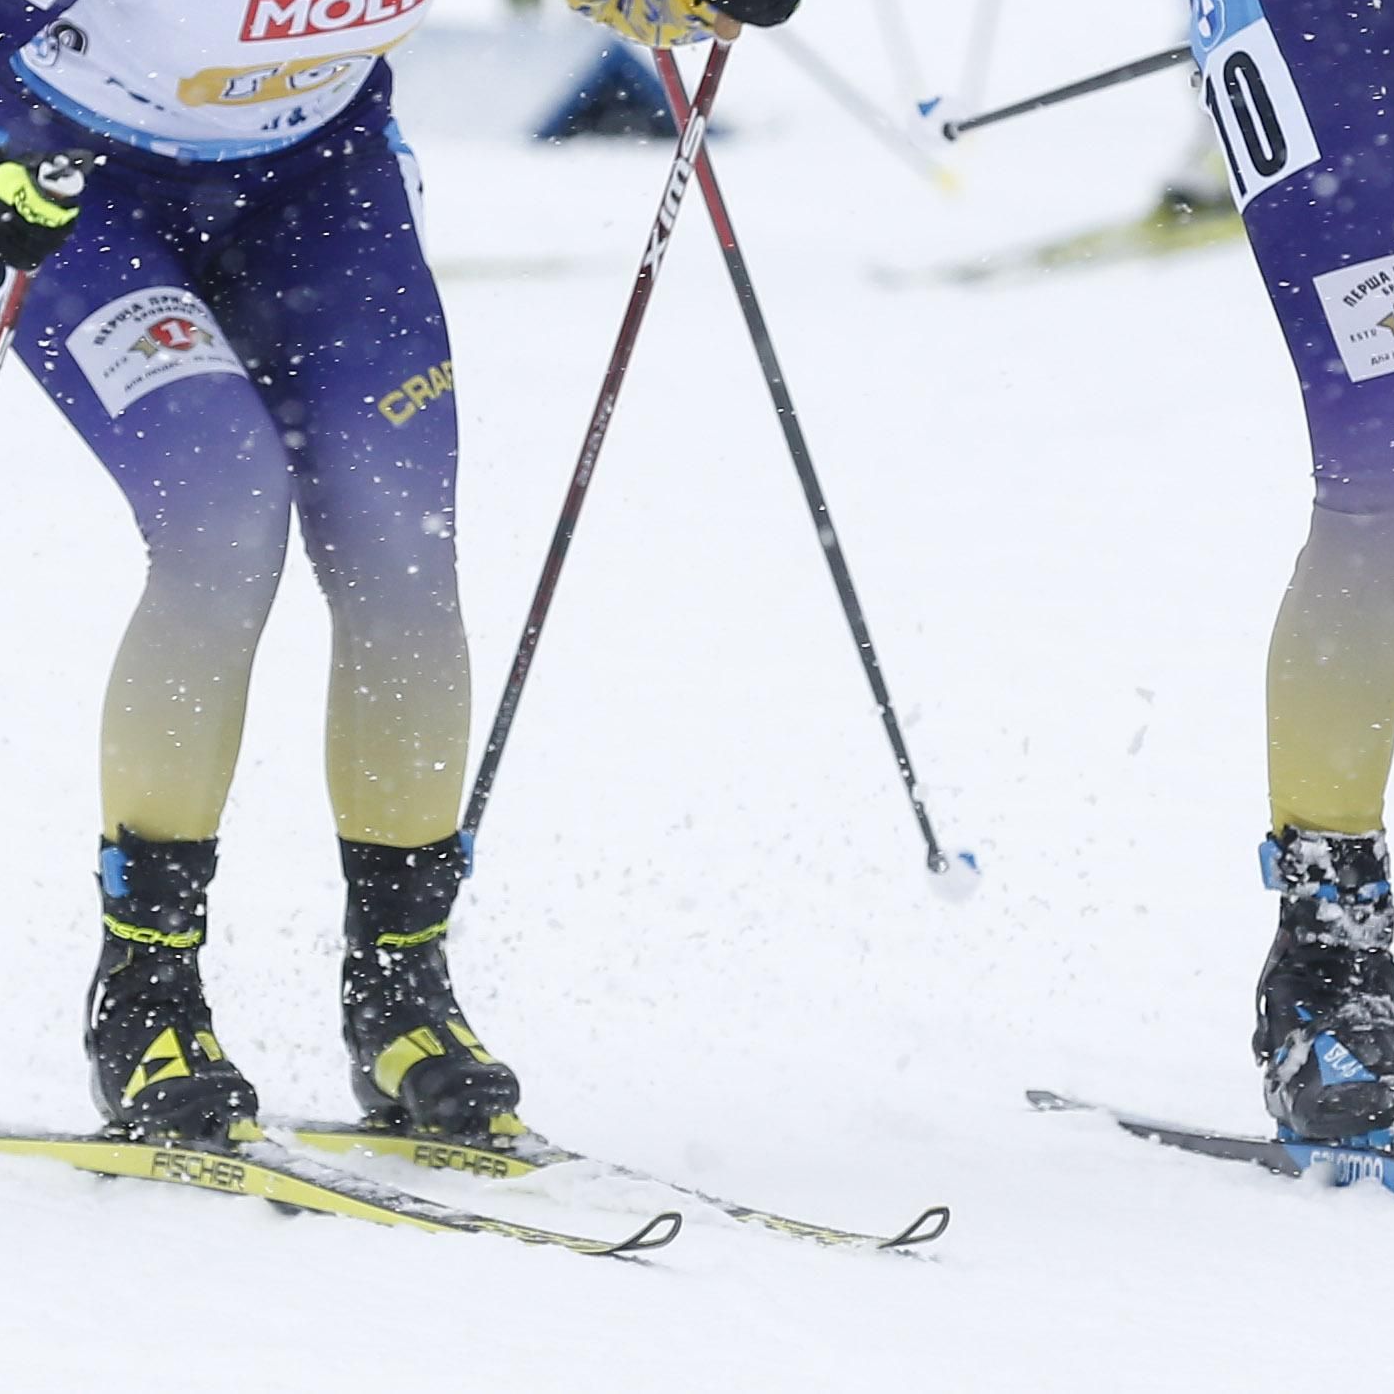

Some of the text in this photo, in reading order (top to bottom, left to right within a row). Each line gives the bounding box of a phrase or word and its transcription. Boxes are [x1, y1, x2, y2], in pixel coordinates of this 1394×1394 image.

[1205, 50, 1288, 197] 10
[1343, 271, 1391, 308] ПЕРША
[161, 320, 191, 346] 1
[151, 1151, 245, 1191] FISCHER
